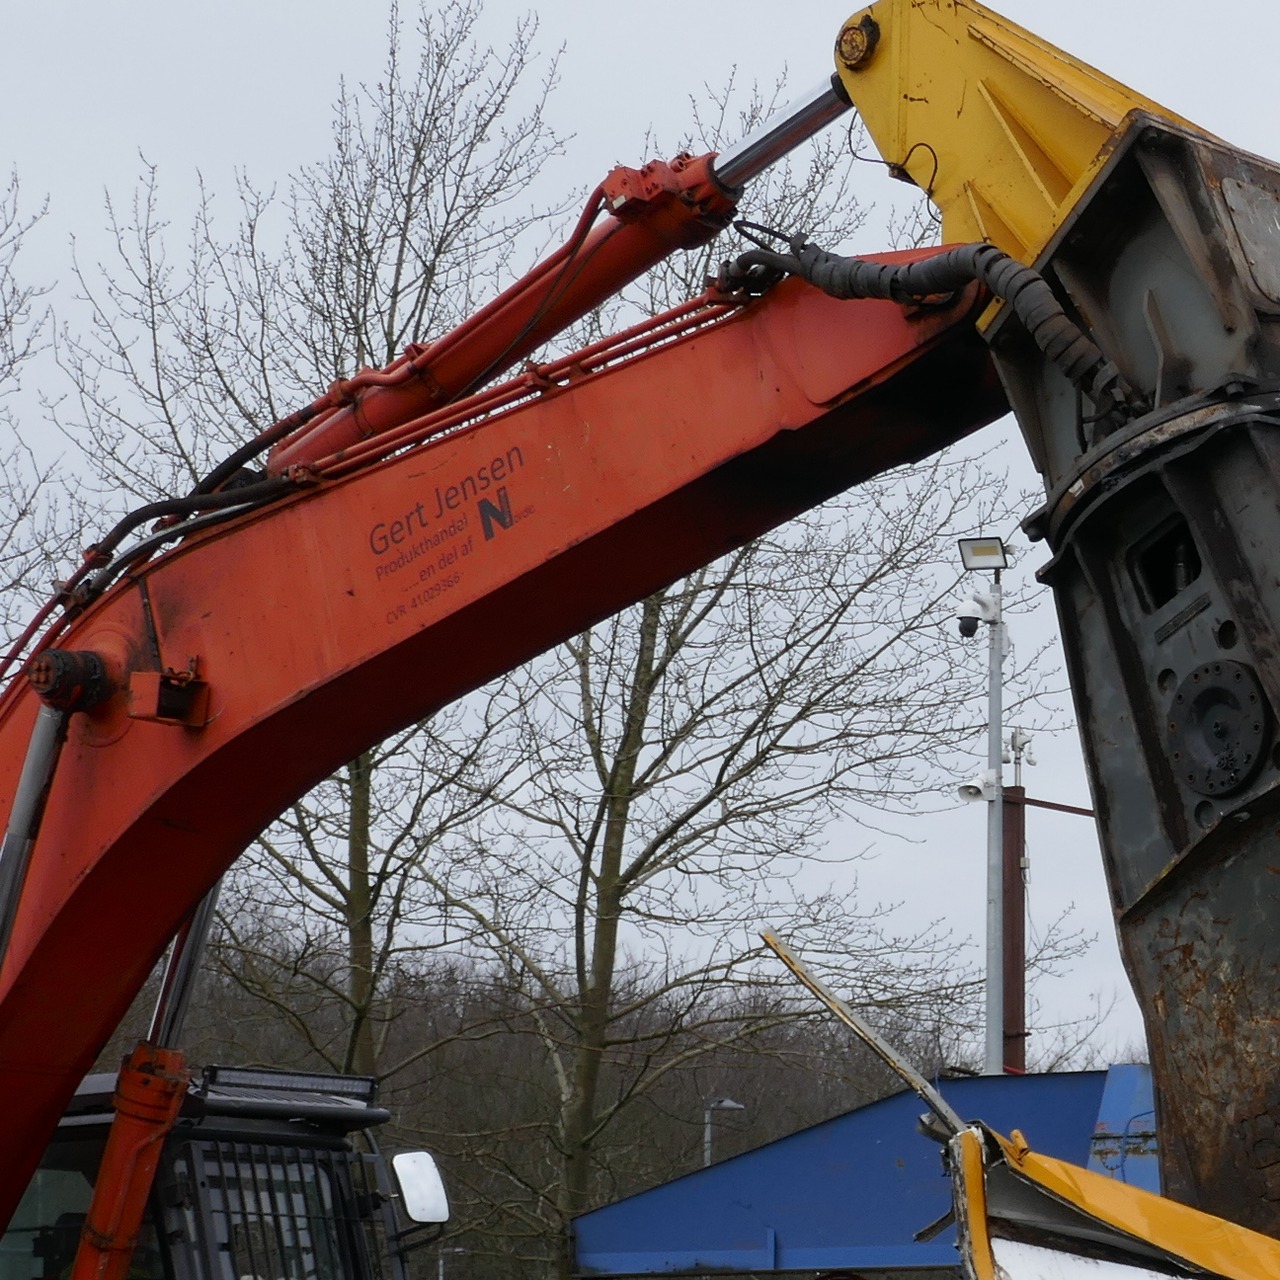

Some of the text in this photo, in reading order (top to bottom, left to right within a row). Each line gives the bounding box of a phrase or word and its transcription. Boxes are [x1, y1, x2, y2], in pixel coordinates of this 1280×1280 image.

[369, 446, 524, 555] Gert Jensen
[376, 513, 469, 581] Produkthandel
[438, 545, 458, 571] del
[461, 537, 474, 557] af
